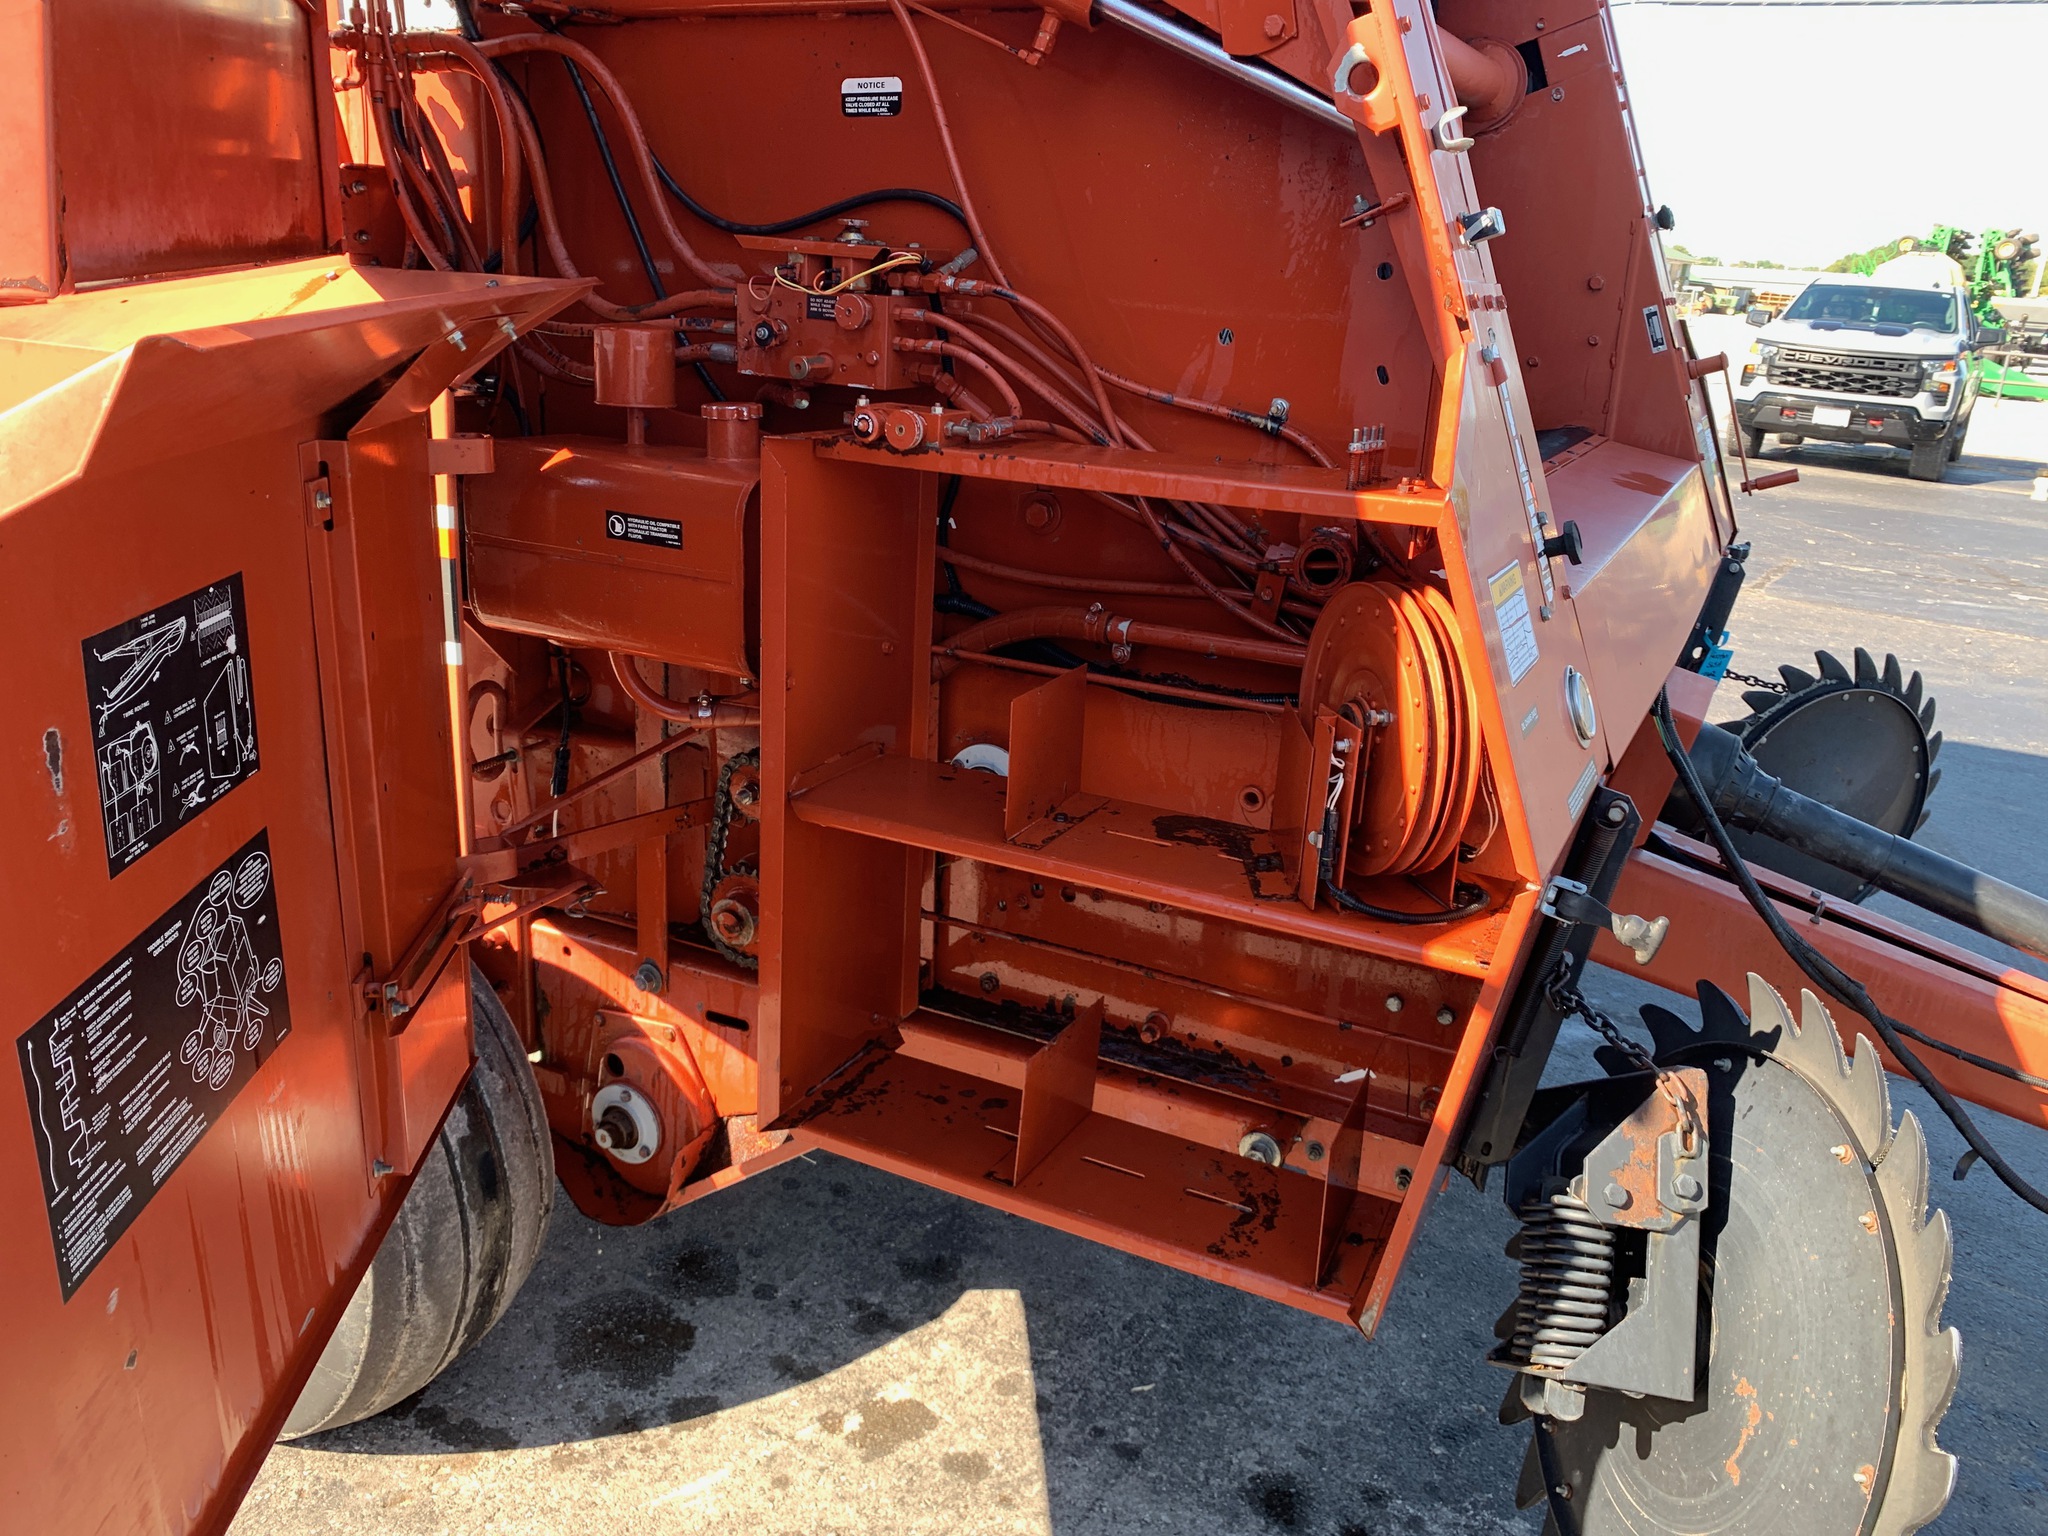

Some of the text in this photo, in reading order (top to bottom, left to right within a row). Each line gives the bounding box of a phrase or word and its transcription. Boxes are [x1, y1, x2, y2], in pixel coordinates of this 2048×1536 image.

[857, 81, 886, 90] NOTICE
[1782, 351, 1918, 372] CHEVROLET
[146, 935, 164, 953] TROUBLE
[164, 919, 181, 938] SHOOTING
[152, 930, 179, 956] QUICK CHECKS
[77, 994, 89, 1007] BELTS
[96, 972, 114, 990] TRACKING
[114, 956, 132, 974] PROPERLY:
[72, 1188, 82, 1200] BALE
[89, 1160, 107, 1181] STARTING
